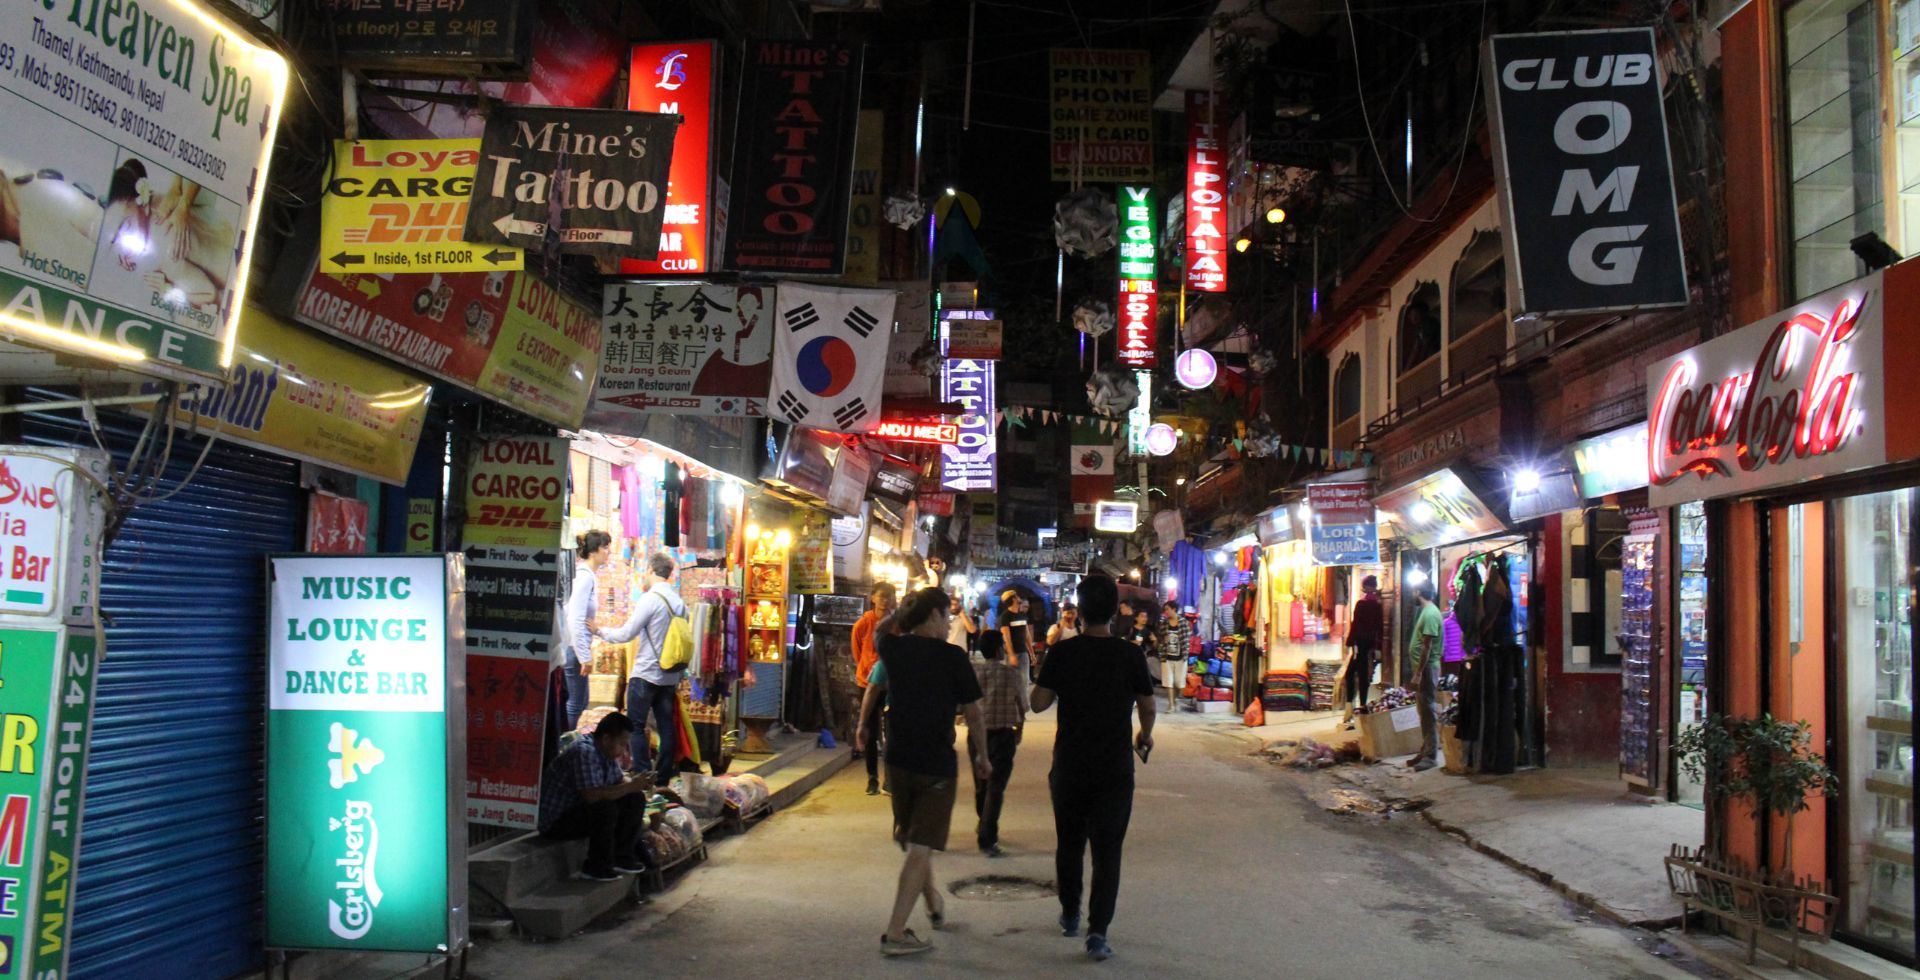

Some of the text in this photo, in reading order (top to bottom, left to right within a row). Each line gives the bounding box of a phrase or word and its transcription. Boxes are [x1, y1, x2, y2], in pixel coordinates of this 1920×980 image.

[32, 16, 165, 113] Thamel, Kathmandu, Nepal
[757, 42, 850, 66] Mine's
[1054, 68, 1136, 84] PRINT
[1502, 53, 1653, 91] CLUB
[201, 32, 252, 141] Spa
[1054, 87, 1149, 102] PHONE
[21, 53, 52, 91] Mob:
[53, 72, 118, 129] 9851156462,
[119, 107, 176, 158] 9810132627,
[176, 137, 227, 182] 9823243082
[1054, 107, 1149, 122] GAME ZONE
[511, 120, 647, 160] Mine's
[1096, 126, 1149, 141] CARD
[351, 145, 479, 172] Loya
[761, 69, 826, 237] TATTOO
[329, 176, 474, 198] CARG
[1551, 99, 1649, 286] OMG
[663, 204, 700, 224] NGE
[1125, 186, 1151, 240] VEG
[1190, 172, 1223, 272] POTALA
[568, 229, 604, 242] Floor
[659, 232, 683, 252] AR
[23, 251, 87, 287] Hot Stone
[374, 250, 473, 266] Inside, 1st FLOOR
[661, 258, 699, 270] CLUB
[1119, 279, 1156, 293] HOTEL
[516, 271, 602, 353] LOYAL CARGO
[1126, 294, 1150, 348] POTALA
[302, 286, 453, 370] KOREAN RESTAURANT
[527, 336, 561, 369] EXPORT
[604, 340, 707, 369] 韩国餐厅
[603, 364, 692, 377] Dae Jang Geum
[599, 376, 692, 393] Korean Restaurant
[1648, 291, 1869, 487] Coca-Cola
[657, 397, 701, 408] Floor
[950, 359, 988, 447] ATTOO
[482, 438, 555, 466] LOYAL
[471, 472, 562, 501] CARGO
[408, 503, 433, 516] LOYAL
[477, 503, 551, 529] DHL
[410, 522, 429, 541] C
[1321, 527, 1366, 539] LORD
[488, 550, 530, 563] First Floor
[1312, 539, 1376, 553] PHARMACY
[11, 545, 52, 583] Bar
[80, 555, 92, 604] BAR
[302, 576, 412, 601] MUSIC
[501, 576, 522, 594] Treks
[523, 579, 531, 594] &
[532, 579, 555, 599] Tours
[287, 618, 427, 642] LOUNGE
[480, 636, 522, 650] First Floor
[346, 648, 366, 667] &
[64, 651, 89, 708] 24
[286, 671, 429, 696] DANCE BAR
[51, 721, 83, 837] Hour
[480, 777, 539, 801] Restaurant
[466, 805, 535, 824] ae Jang Geum
[328, 799, 384, 941] Carlsberg
[39, 850, 70, 956] ATM
